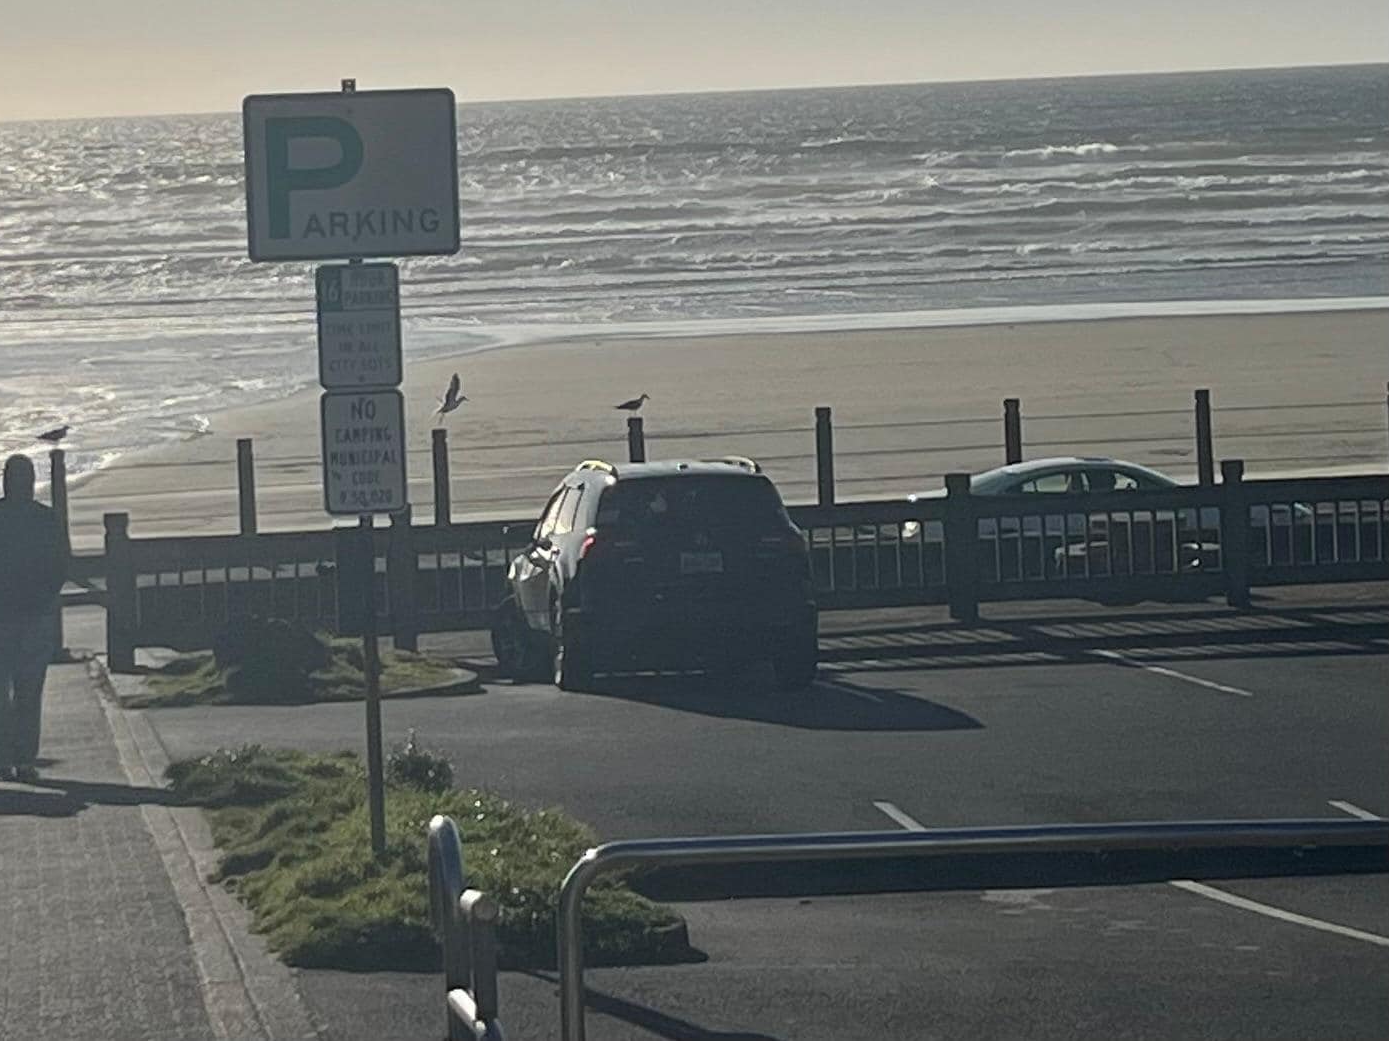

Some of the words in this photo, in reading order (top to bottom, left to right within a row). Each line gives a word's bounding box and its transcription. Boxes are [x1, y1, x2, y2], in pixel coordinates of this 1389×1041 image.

[351, 398, 376, 420] NO
[335, 426, 392, 444] CAMPING
[330, 449, 397, 466] MUNICIPAL
[352, 470, 381, 486] CODE
